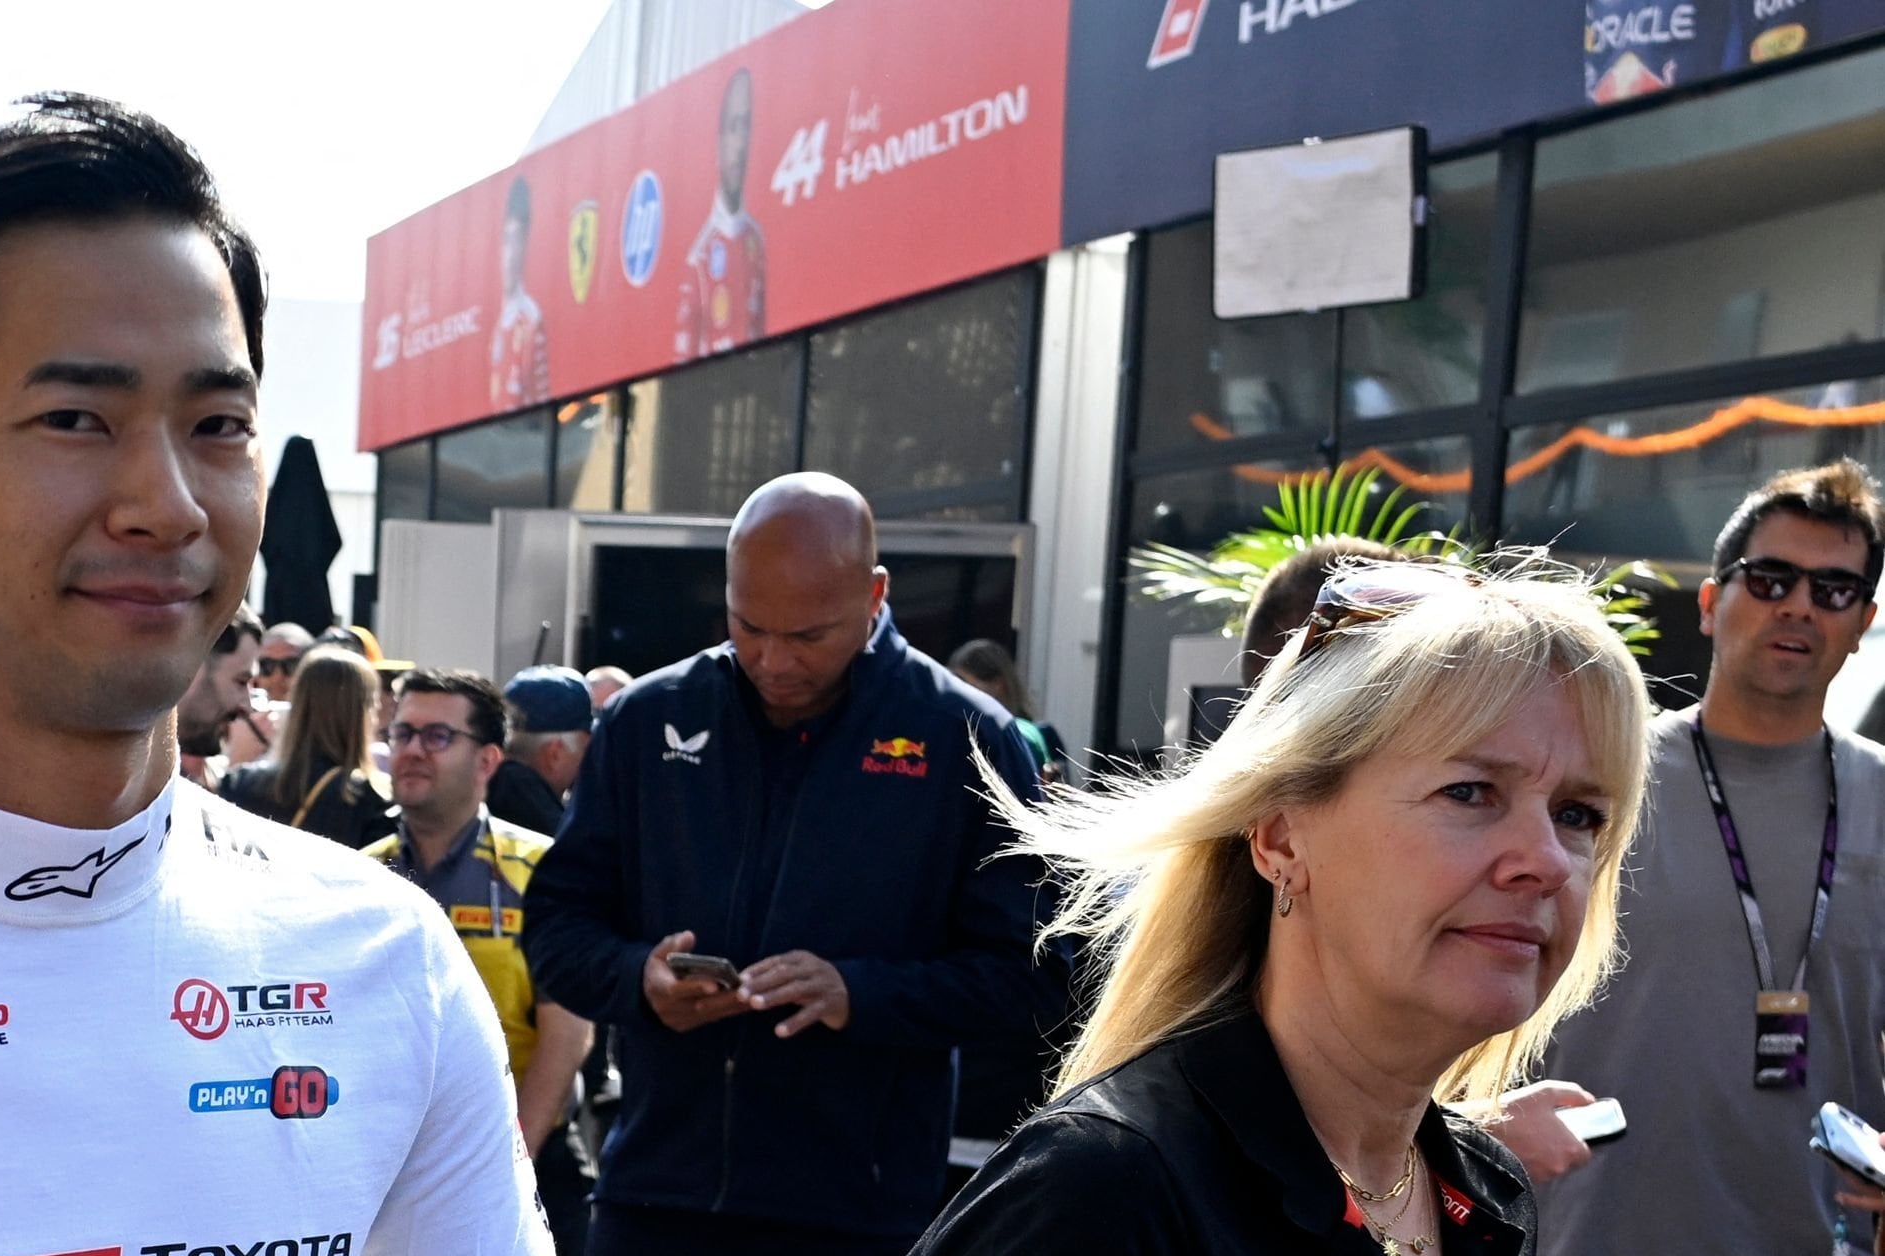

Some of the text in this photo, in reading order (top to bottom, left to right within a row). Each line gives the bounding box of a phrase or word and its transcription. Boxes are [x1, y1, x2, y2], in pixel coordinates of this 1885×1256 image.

[835, 85, 1029, 190] HAMILTON
[770, 119, 828, 207] 44
[862, 756, 928, 778] Red Bull
[227, 982, 327, 1013] TGR
[294, 1015, 333, 1027] TEAM
[273, 1071, 327, 1115] GO
